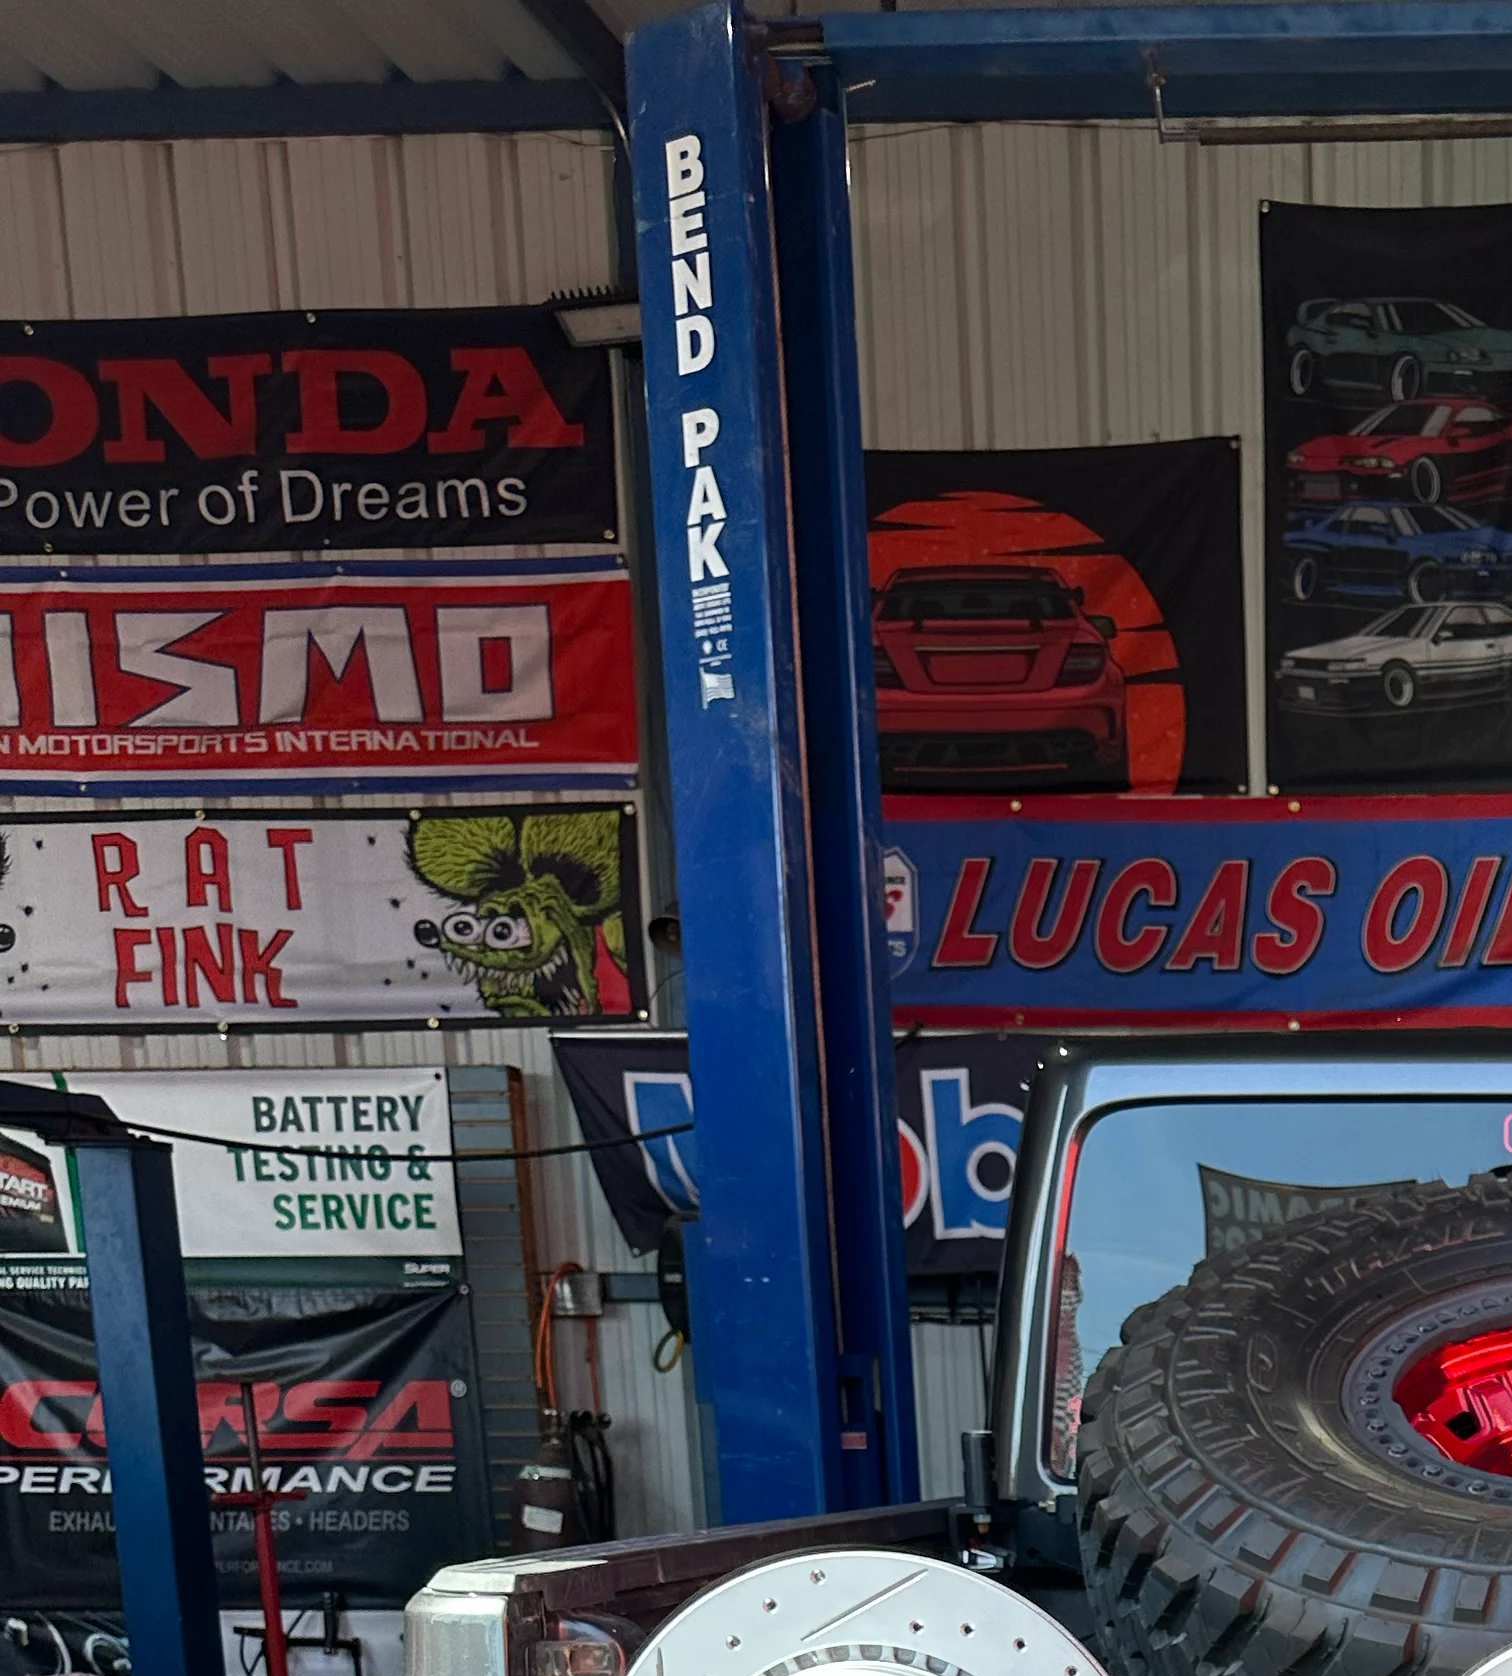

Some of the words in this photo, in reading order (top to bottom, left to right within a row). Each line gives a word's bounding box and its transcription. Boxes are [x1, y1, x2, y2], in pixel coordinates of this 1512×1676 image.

[664, 135, 715, 376] BEND
[0, 345, 584, 466] ONDA
[199, 470, 259, 525] of
[280, 469, 528, 525] Dreams
[682, 408, 731, 582] PAK
[19, 731, 267, 756] MOTORSPORTS
[275, 727, 540, 752] INTERNATIONAL
[931, 854, 1336, 977] LUCAS
[114, 922, 298, 1009] FINK
[252, 1095, 425, 1133] BATTERY
[227, 1144, 393, 1182] TESTING
[407, 1144, 434, 1182] &
[272, 1192, 437, 1231] SERVICE
[16, 1276, 66, 1290] QUALITY
[0, 1380, 454, 1457] CRSA
[309, 1510, 410, 1533] HEADERS
